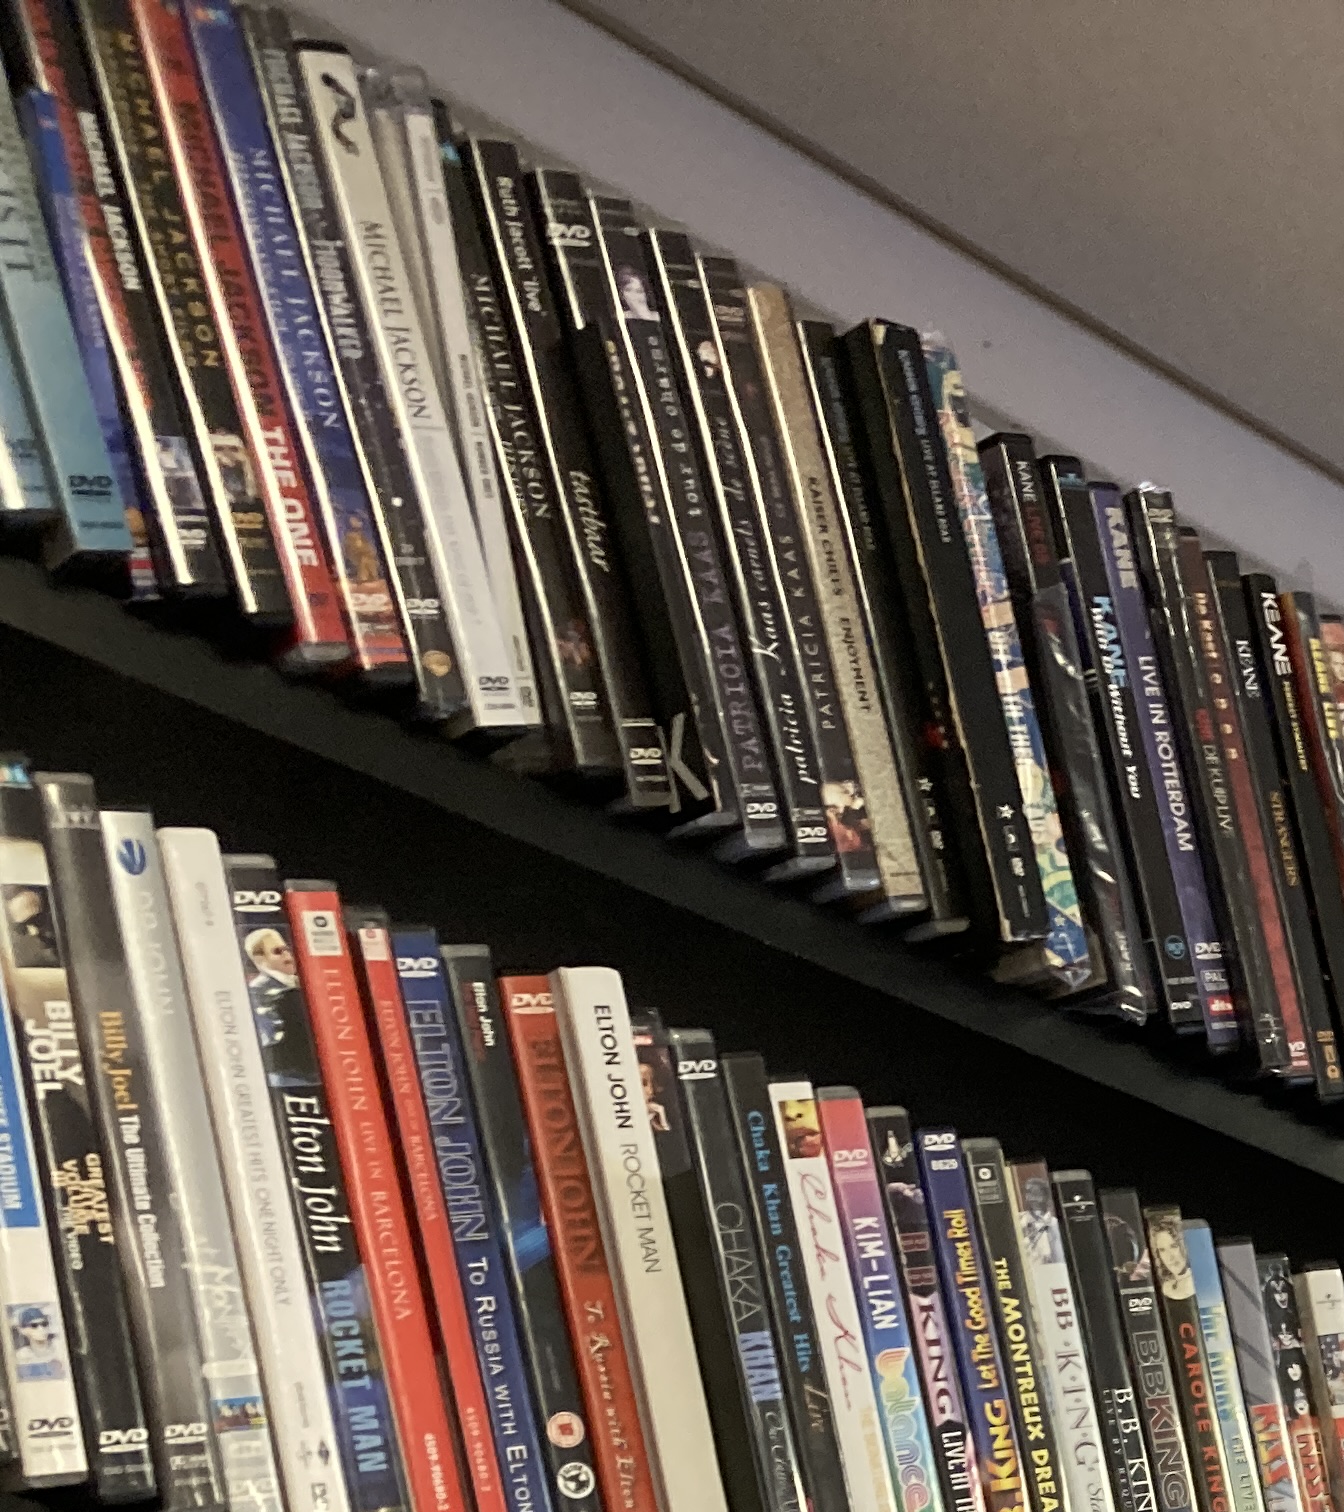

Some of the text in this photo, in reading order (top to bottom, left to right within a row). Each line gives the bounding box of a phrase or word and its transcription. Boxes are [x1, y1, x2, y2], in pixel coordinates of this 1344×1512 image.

[359, 219, 431, 421] MICHAEL JACKSON
[263, 425, 319, 567] THE ONE
[1015, 460, 1036, 504] KANE
[777, 533, 838, 731] PATRICIA KAAS
[807, 475, 874, 713] KAISER CHIEFS ENJOYMENT
[1260, 591, 1293, 677] KEANE
[1103, 506, 1196, 853] KANE LIVE IN ROTTERDAM
[1236, 639, 1261, 698] KEANE
[667, 712, 712, 813] K
[234, 892, 282, 907] DVD
[24, 1000, 85, 1100] BILLY JOEL
[338, 1050, 369, 1112] JOHN
[408, 998, 467, 1126] ELTON
[677, 1059, 718, 1074] DVD
[101, 1011, 166, 1289] Billy Joel The Ultimate Collection
[214, 990, 293, 1307] ELTON JOHN GREATEST HITS ONE NIGHT ONLY
[284, 1093, 353, 1254] Elton John
[434, 1135, 490, 1244] JOHN
[592, 1004, 664, 1275] ELTON JOHN ROCKET MAN
[466, 1256, 490, 1287] To
[714, 1202, 763, 1324] CHAKA
[746, 1110, 801, 1324] Chaka Khan Greatest
[851, 1216, 899, 1332] KIM-LIAN
[993, 1256, 1013, 1292] THE
[321, 1279, 390, 1473] ROCKET MAN
[473, 1296, 506, 1377] RUSSIA
[917, 1302, 956, 1427] KING
[1000, 1296, 1045, 1443] MONTREUX
[1178, 1321, 1211, 1434] CAROLE
[493, 1383, 517, 1437] WITH
[981, 1399, 1022, 1493] KING
